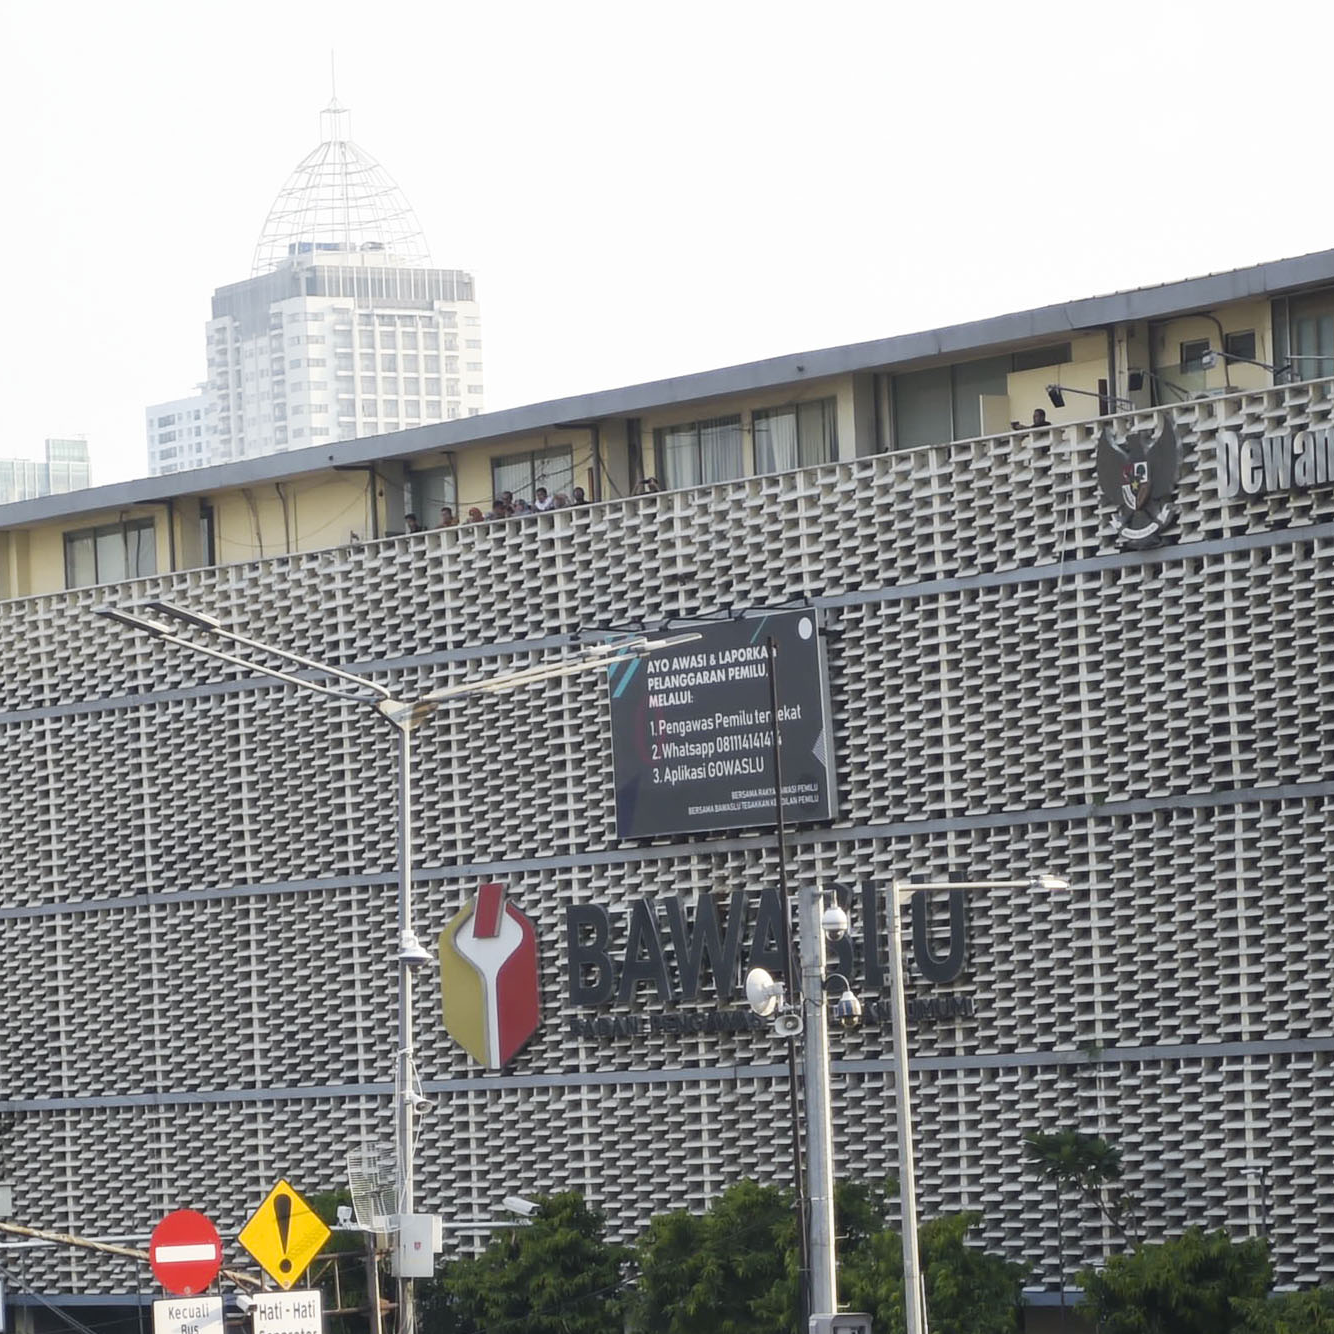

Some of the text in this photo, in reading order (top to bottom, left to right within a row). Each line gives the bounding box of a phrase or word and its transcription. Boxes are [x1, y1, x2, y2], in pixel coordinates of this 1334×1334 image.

[647, 658, 668, 674] AYO
[672, 654, 707, 671] AWASI
[710, 654, 716, 665] &
[648, 669, 725, 691] PELANGGARAN
[649, 690, 693, 708] MELALUI:
[650, 704, 801, 737] 1. Pengawas Pemilu terekat
[652, 744, 661, 760] 2.
[662, 741, 715, 758] Whatsapp
[653, 756, 764, 786] 3. Aplikasi GOWASLU
[758, 787, 776, 796] RAKYA
[168, 1304, 209, 1320] Kecuali
[260, 1303, 283, 1321] Hati
[293, 1300, 316, 1319] Hati
